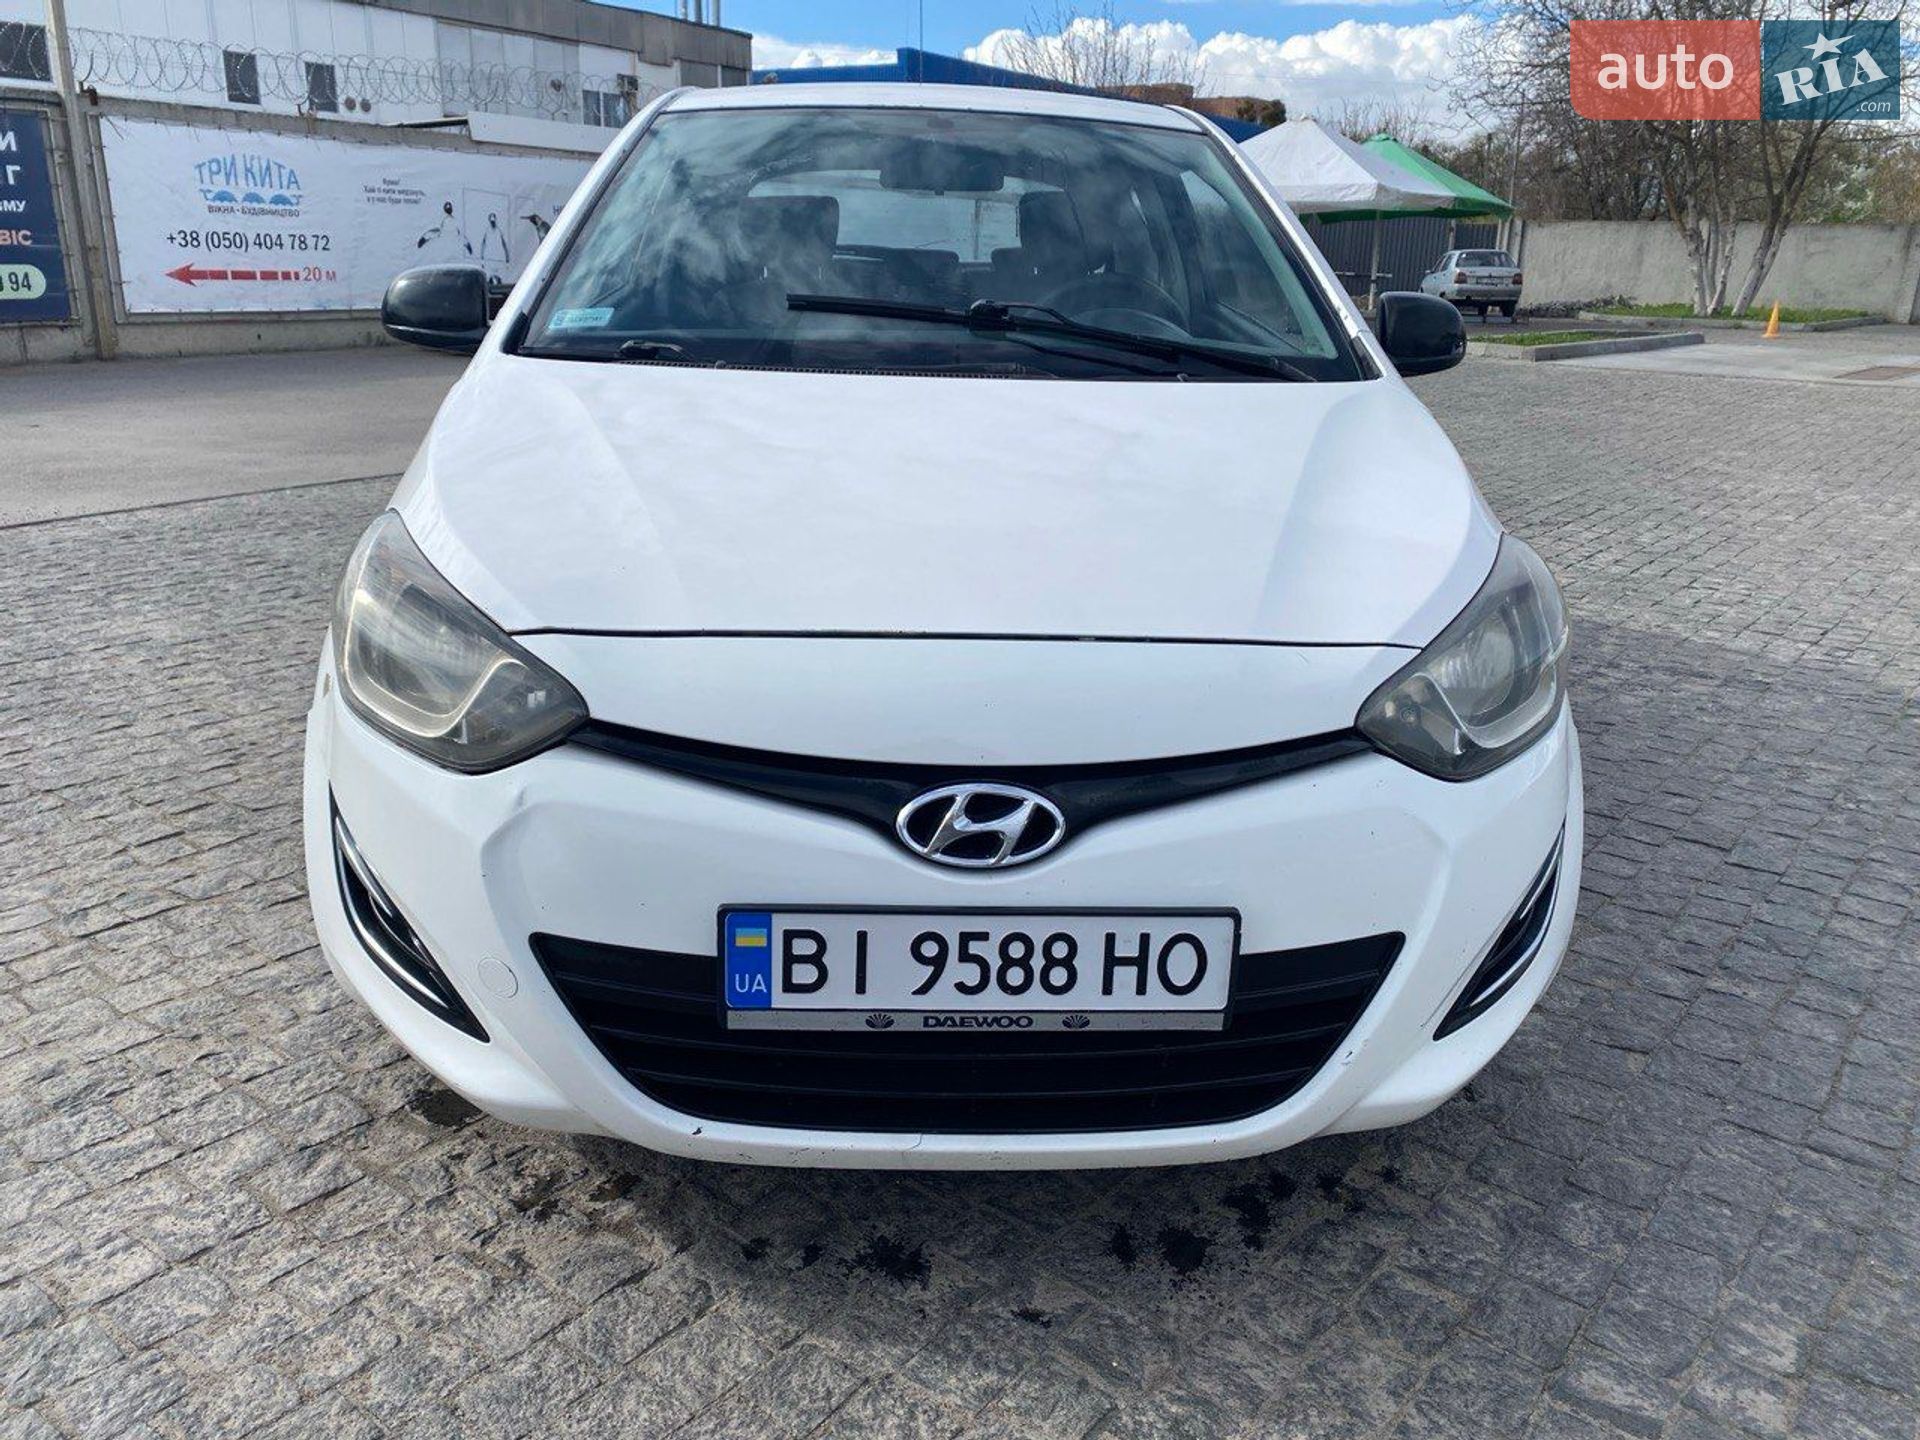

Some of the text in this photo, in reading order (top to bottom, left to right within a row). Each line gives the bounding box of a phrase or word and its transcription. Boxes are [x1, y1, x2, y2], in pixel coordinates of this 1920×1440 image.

[195, 153, 301, 190] ТРИ КИТА
[167, 230, 331, 252] +38 (050) 404 78 72
[8, 271, 32, 292] 94
[302, 266, 322, 282] 20
[910, 931, 1079, 996] 9588
[1101, 932, 1208, 996] HO
[735, 973, 767, 993] UA
[922, 1014, 1034, 1030] DAEWOO
